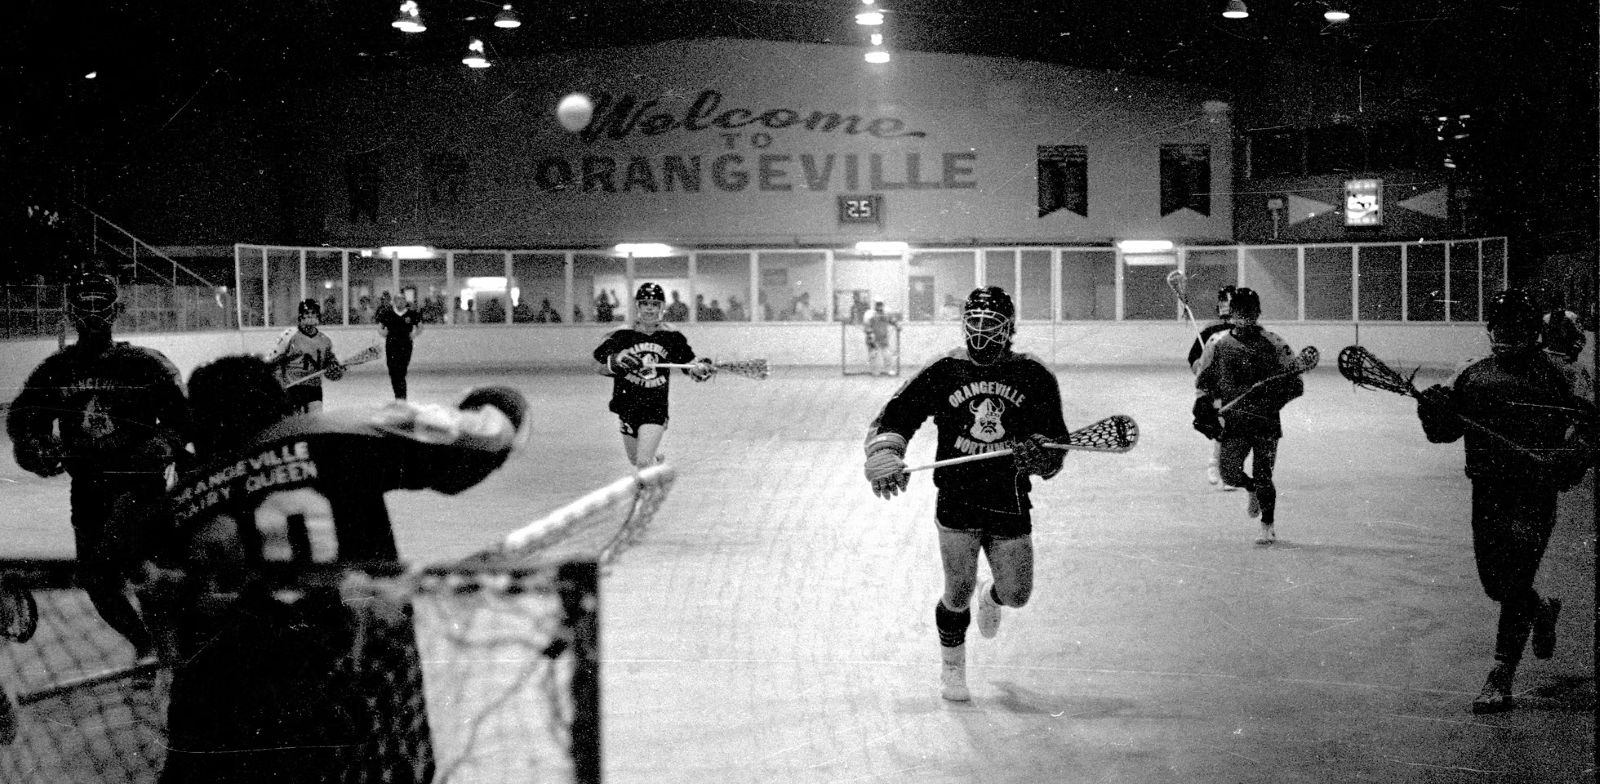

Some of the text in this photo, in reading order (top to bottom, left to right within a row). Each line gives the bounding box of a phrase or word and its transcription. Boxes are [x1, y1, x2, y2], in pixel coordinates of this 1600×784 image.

[580, 89, 926, 141] Welcome
[719, 132, 772, 149] TO
[535, 154, 977, 193] ORANGEVILLE
[847, 200, 871, 217] 25
[627, 342, 668, 359] RANGEVILLE
[948, 381, 1026, 408] ORANGEVILLE
[953, 436, 1014, 456] NORTHM
[173, 441, 310, 505] RANGEVILLE
[245, 459, 318, 493] QUEEN
